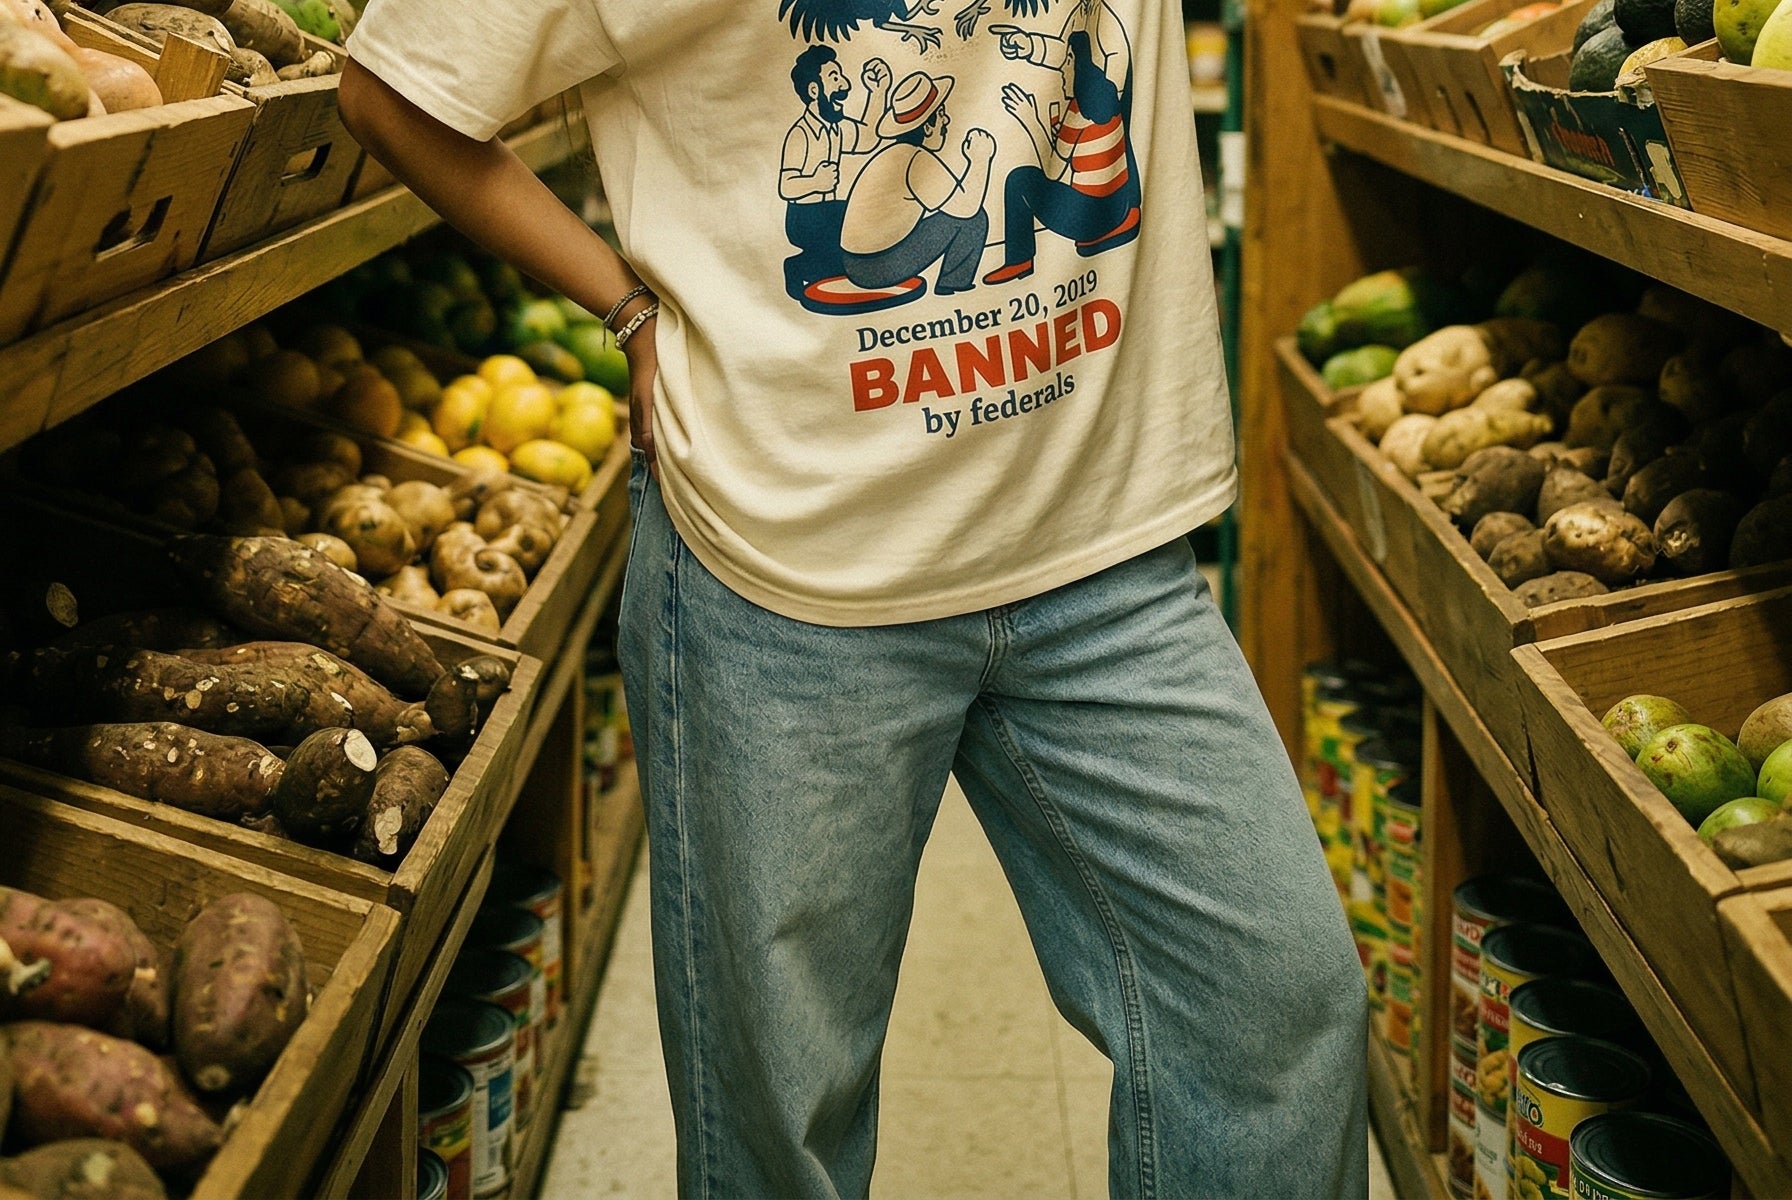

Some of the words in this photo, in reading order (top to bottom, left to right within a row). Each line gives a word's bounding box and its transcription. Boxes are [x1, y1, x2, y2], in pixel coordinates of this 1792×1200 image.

[856, 306, 1002, 353] December
[1009, 293, 1049, 320] 20,
[1054, 270, 1098, 308] 2019
[850, 298, 1122, 412] BANNED
[922, 407, 962, 438] by
[970, 373, 1076, 426] federals
